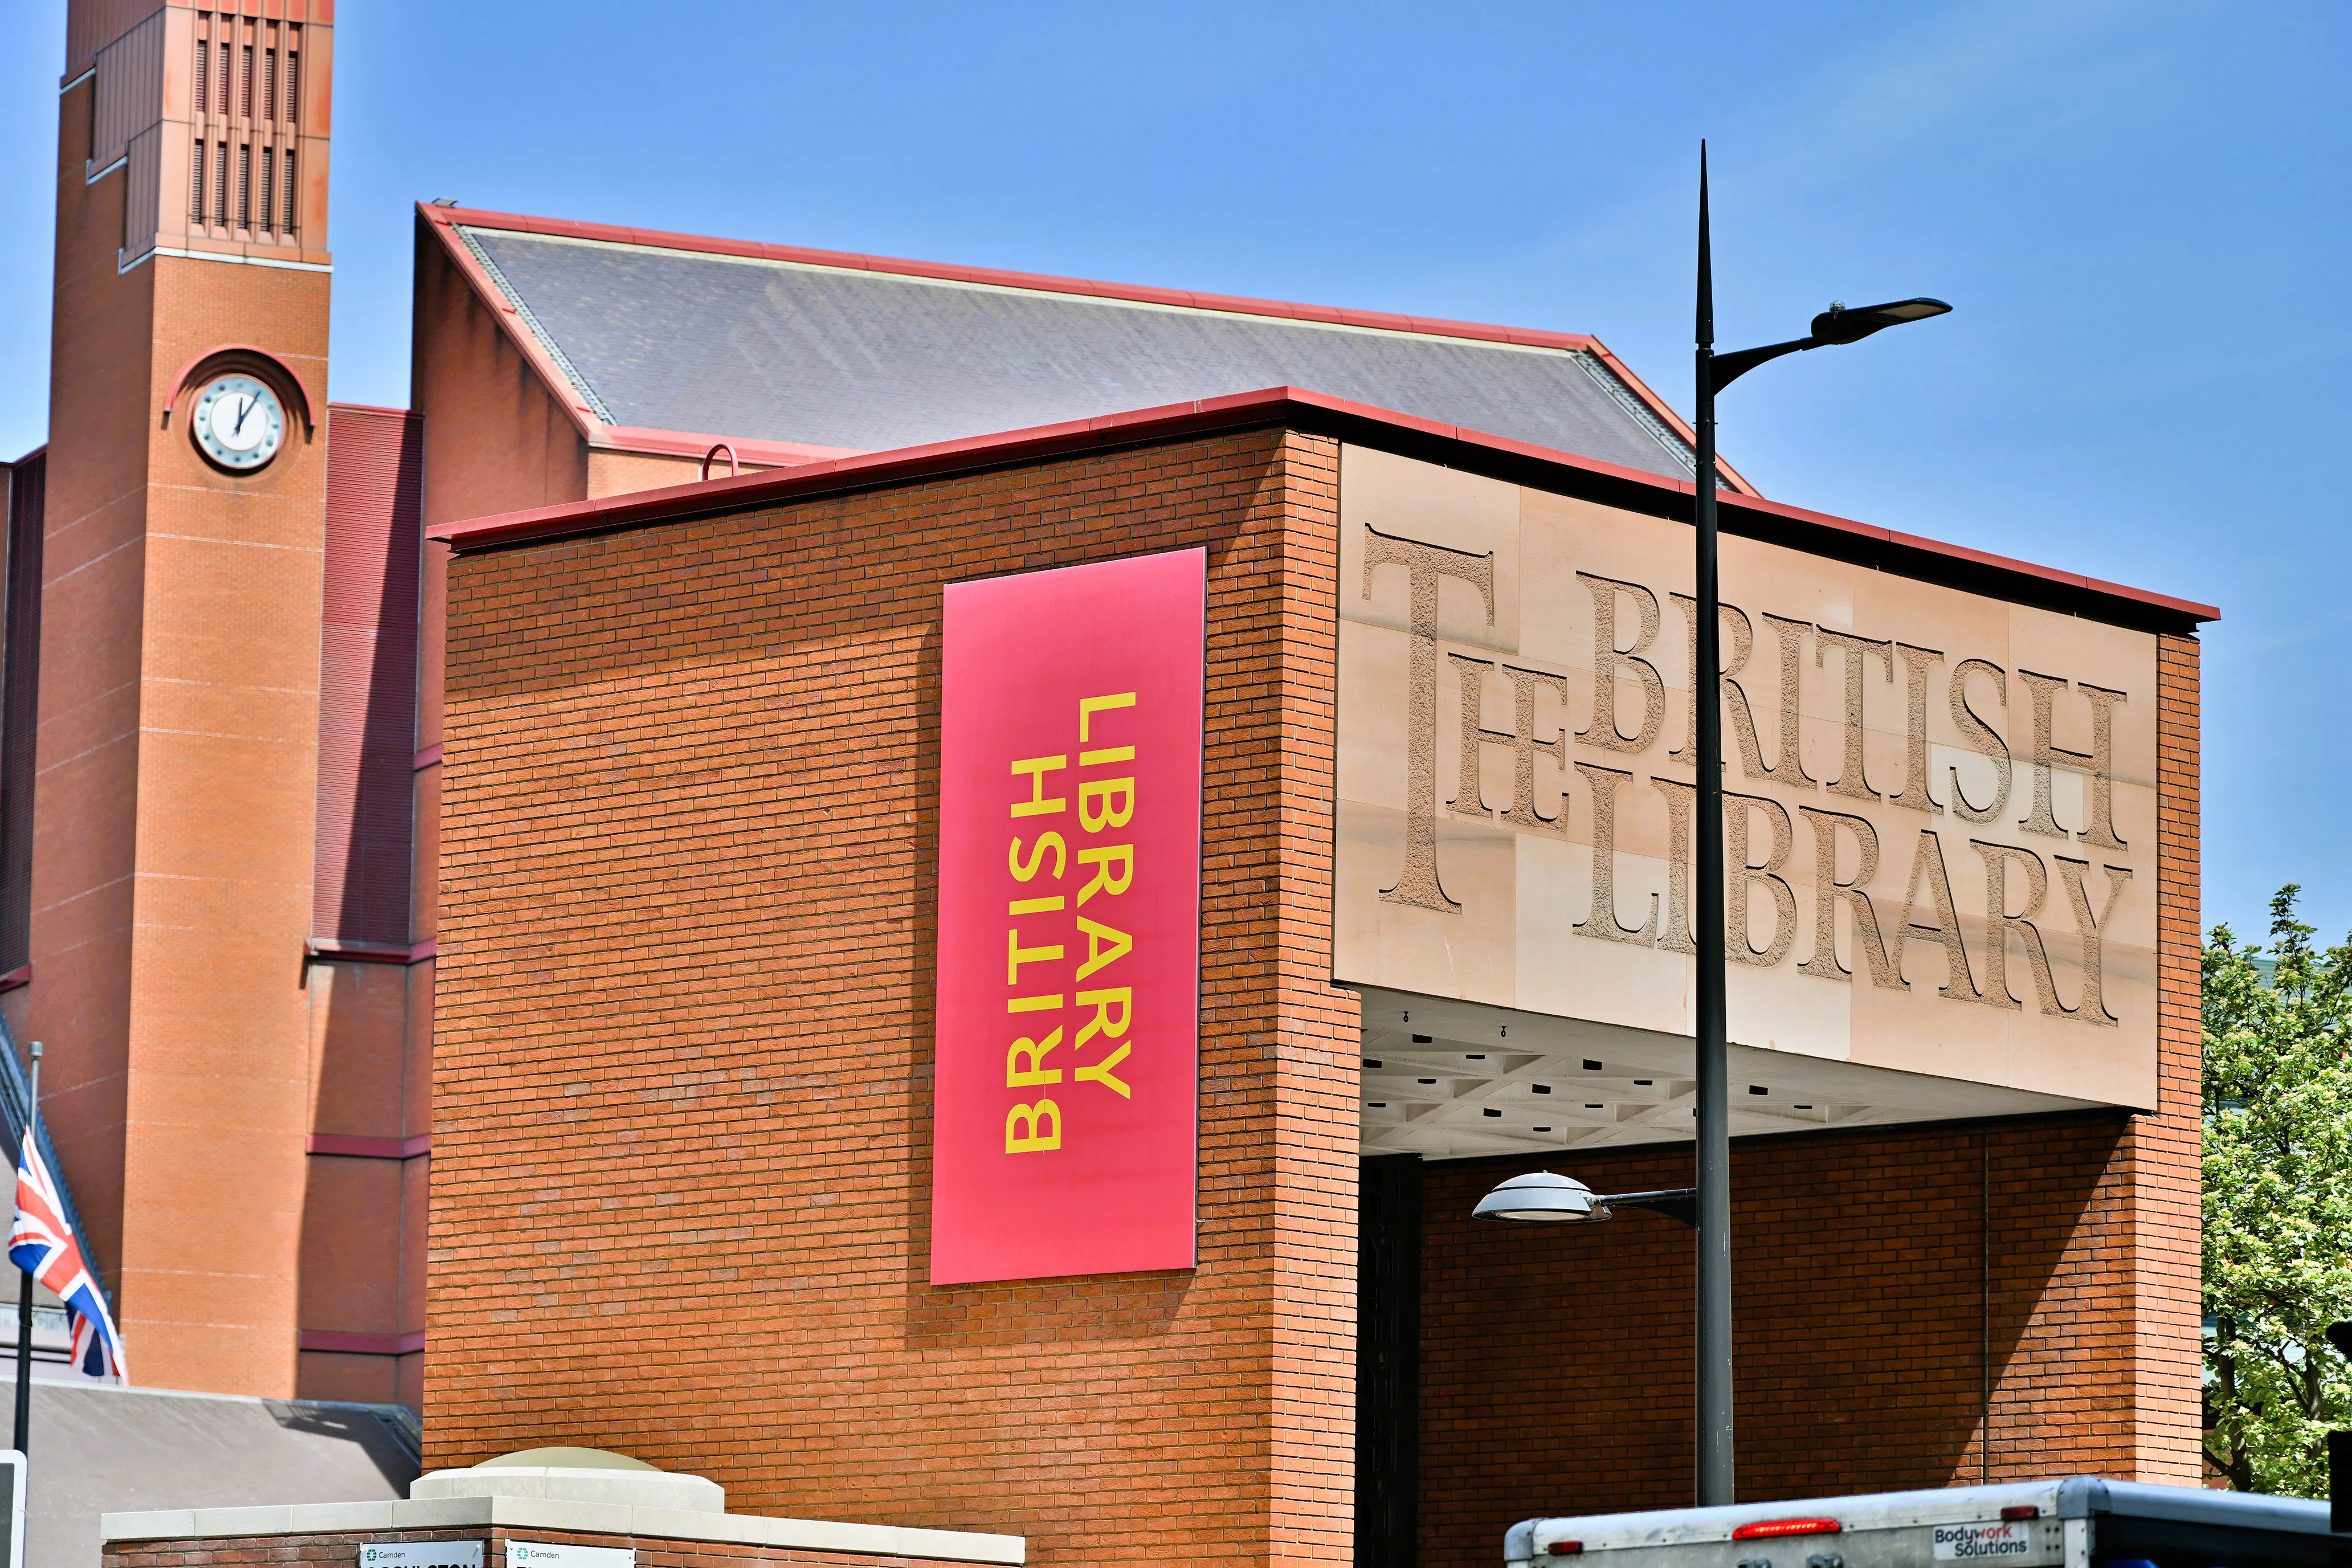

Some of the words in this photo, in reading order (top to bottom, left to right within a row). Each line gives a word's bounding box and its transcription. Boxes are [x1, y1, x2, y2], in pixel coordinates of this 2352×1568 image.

[1362, 522, 1568, 913] THE
[1575, 570, 2128, 851] BRITISH
[1006, 754, 1067, 1155] BRITISH
[1075, 692, 1136, 1100] LIBRARY
[1572, 761, 2133, 1027] LIBRARY
[530, 1550, 560, 1559] Camden
[1935, 1524, 2012, 1544] Bodywork
[1955, 1540, 2027, 1557] Solutions
